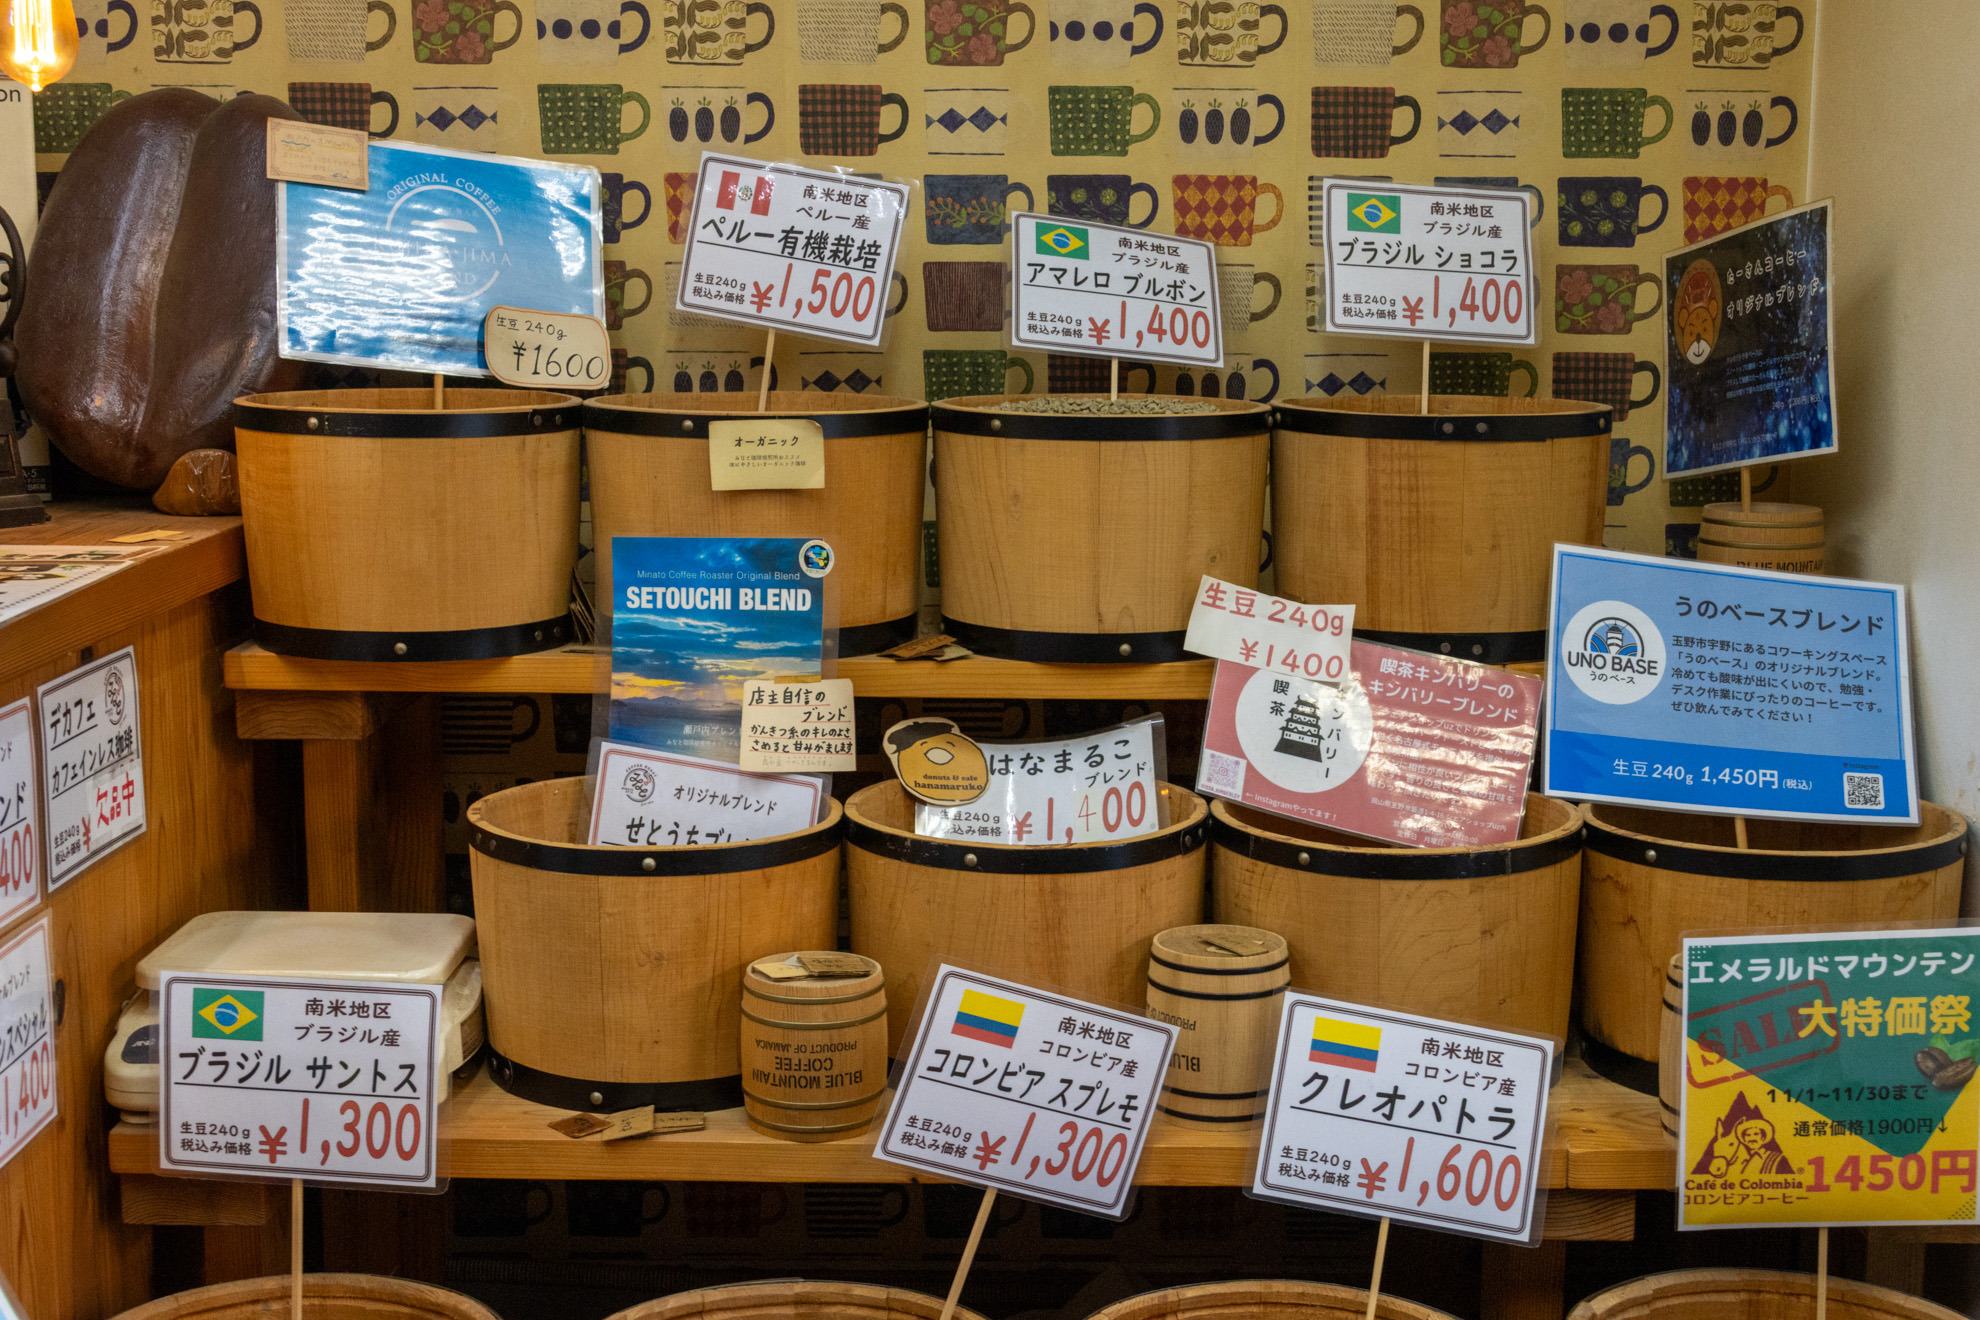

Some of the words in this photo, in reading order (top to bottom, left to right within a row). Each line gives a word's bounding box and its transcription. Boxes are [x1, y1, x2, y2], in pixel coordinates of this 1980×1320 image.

[386, 172, 448, 201] ORIGINAL
[455, 177, 502, 216] COFFEE
[803, 184, 869, 208] 南米地区
[796, 205, 871, 230] ペルー産
[1430, 202, 1495, 218] 南米地区
[702, 216, 882, 270] ペルー有機栽培
[1423, 221, 1502, 239] ブラジル産
[1118, 236, 1181, 257] 南米地区
[1338, 237, 1424, 265] ブラジル
[1435, 245, 1518, 273] ショコラ
[1112, 252, 1190, 274] ブラジル産
[692, 286, 745, 305] 税込み価格
[694, 272, 747, 291] 生豆240g
[750, 262, 875, 322] ¥1,500
[1027, 262, 1110, 288] アマレロ
[1123, 272, 1206, 303] ブルボン
[1342, 293, 1396, 307] 生豆240g
[1342, 306, 1397, 320] 税込み価格
[1402, 275, 1523, 328] ¥1,400
[1027, 311, 1082, 326] 生豆240g
[1027, 323, 1083, 339] 税込み価格
[1088, 300, 1210, 348] ¥1,400
[513, 340, 604, 380] ¥1600
[734, 435, 799, 448] オーガニック
[637, 570, 666, 579] Minato
[668, 570, 697, 580] Coffee
[700, 570, 734, 580] Roaster
[736, 571, 772, 582] Original
[774, 571, 800, 581] Blend
[626, 586, 732, 610] SETOUCHI
[739, 587, 812, 611] BLEND
[1675, 595, 1885, 636] うのベースブレンド
[1238, 637, 1344, 680] ¥1400
[1567, 650, 1607, 671] UNO
[1611, 655, 1658, 676] BASE
[1671, 634, 1887, 666] 玉野市宇野にあるコワーキングスペース
[1380, 657, 1515, 699] 喫茶キンバリーの
[1589, 670, 1636, 684] うのベース
[1678, 651, 1882, 683] 「うのベース」のオリジナルブレンド。
[1671, 667, 1873, 696] 冷めても酸味が出にくいので、勉強・
[748, 686, 826, 706] 店主自信の
[1269, 679, 1290, 718] 喫茶
[1368, 680, 1519, 723] キンバリーブレンド
[1671, 684, 1883, 713] デスク作業にぴったりのコーヒーです。
[50, 697, 97, 744] デカフェ
[803, 705, 847, 722] ブレンド
[52, 724, 134, 794] カフェインレス珈琲
[989, 739, 1132, 776] はなまるこ
[914, 780, 984, 792] hanamaruko
[923, 773, 951, 781] donuts
[961, 774, 978, 782] cafe
[1084, 761, 1147, 788] ブレンド
[1700, 765, 1779, 789] 1,450円
[96, 771, 135, 828] 欠品中
[673, 784, 778, 816] オリジナルブレンド
[1689, 952, 1975, 984] エメラルドマウンテン
[305, 997, 392, 1019] 南米地区
[1798, 994, 1972, 1038] 大特価祭
[294, 1023, 401, 1047] ブラジル産
[809, 1040, 858, 1054] PRODUCT
[1058, 1016, 1134, 1050] 南米地区
[794, 1043, 807, 1054] OF
[1039, 1039, 1140, 1078] コロンビア産
[1421, 1037, 1505, 1068] 南米地区
[179, 1046, 292, 1084] ブラジル
[306, 1055, 418, 1093] サントス
[774, 1055, 834, 1072] COFFEE
[752, 1067, 820, 1089] MOUNTAIN
[824, 1069, 863, 1088] BLUE
[926, 1049, 1046, 1098] コロンビア
[1048, 1078, 1139, 1123] スプレモ
[1405, 1062, 1517, 1097] コロンビア産
[1299, 1071, 1516, 1141] クレオパトラ
[180, 1121, 251, 1139] 生豆240g
[259, 1097, 421, 1166] ¥1,300
[905, 1115, 973, 1143] 生豆240g
[180, 1138, 252, 1155] 税込み価格
[900, 1131, 967, 1159] 税込み価格
[972, 1111, 1128, 1188] ¥1,300
[1280, 1145, 1351, 1169] 生豆240g
[1278, 1162, 1350, 1187] 税込み価格
[1357, 1136, 1522, 1212] ¥1,600
[1685, 1178, 1717, 1191] Café
[1720, 1179, 1736, 1191] de
[1739, 1178, 1804, 1191] Colombia
[1805, 1150, 1977, 1195] 1450円
[1684, 1193, 1810, 1206] コロンビアコーヒー
